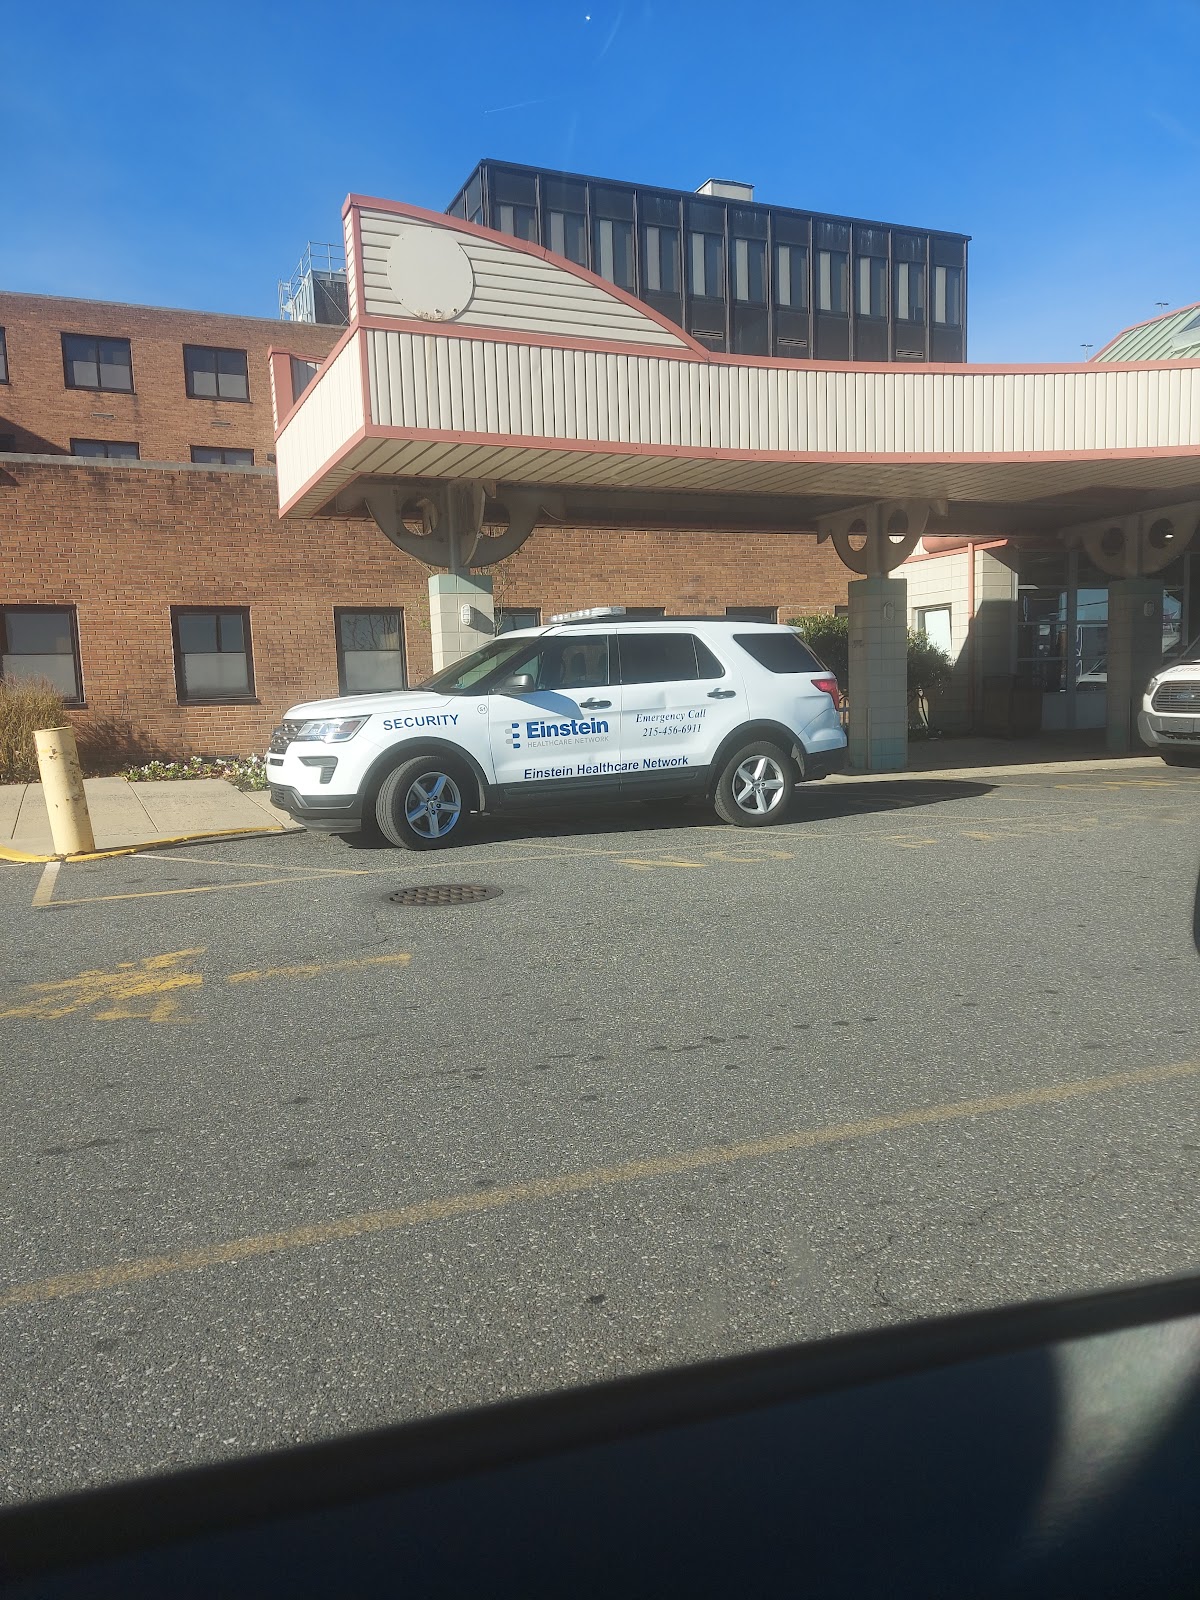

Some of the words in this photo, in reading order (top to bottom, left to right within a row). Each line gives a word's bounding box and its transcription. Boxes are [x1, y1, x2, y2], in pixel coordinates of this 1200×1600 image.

[383, 714, 459, 731] SECURITY
[636, 713, 685, 723] Emergency
[688, 709, 706, 719] Call
[526, 718, 609, 739] Einstein
[642, 724, 702, 737] 215-456-6911
[527, 738, 572, 748] HEALTHCARE
[574, 736, 609, 744] NETWORK
[524, 766, 573, 779] Einstein
[577, 762, 639, 775] Healthcare
[642, 755, 689, 769] Network
